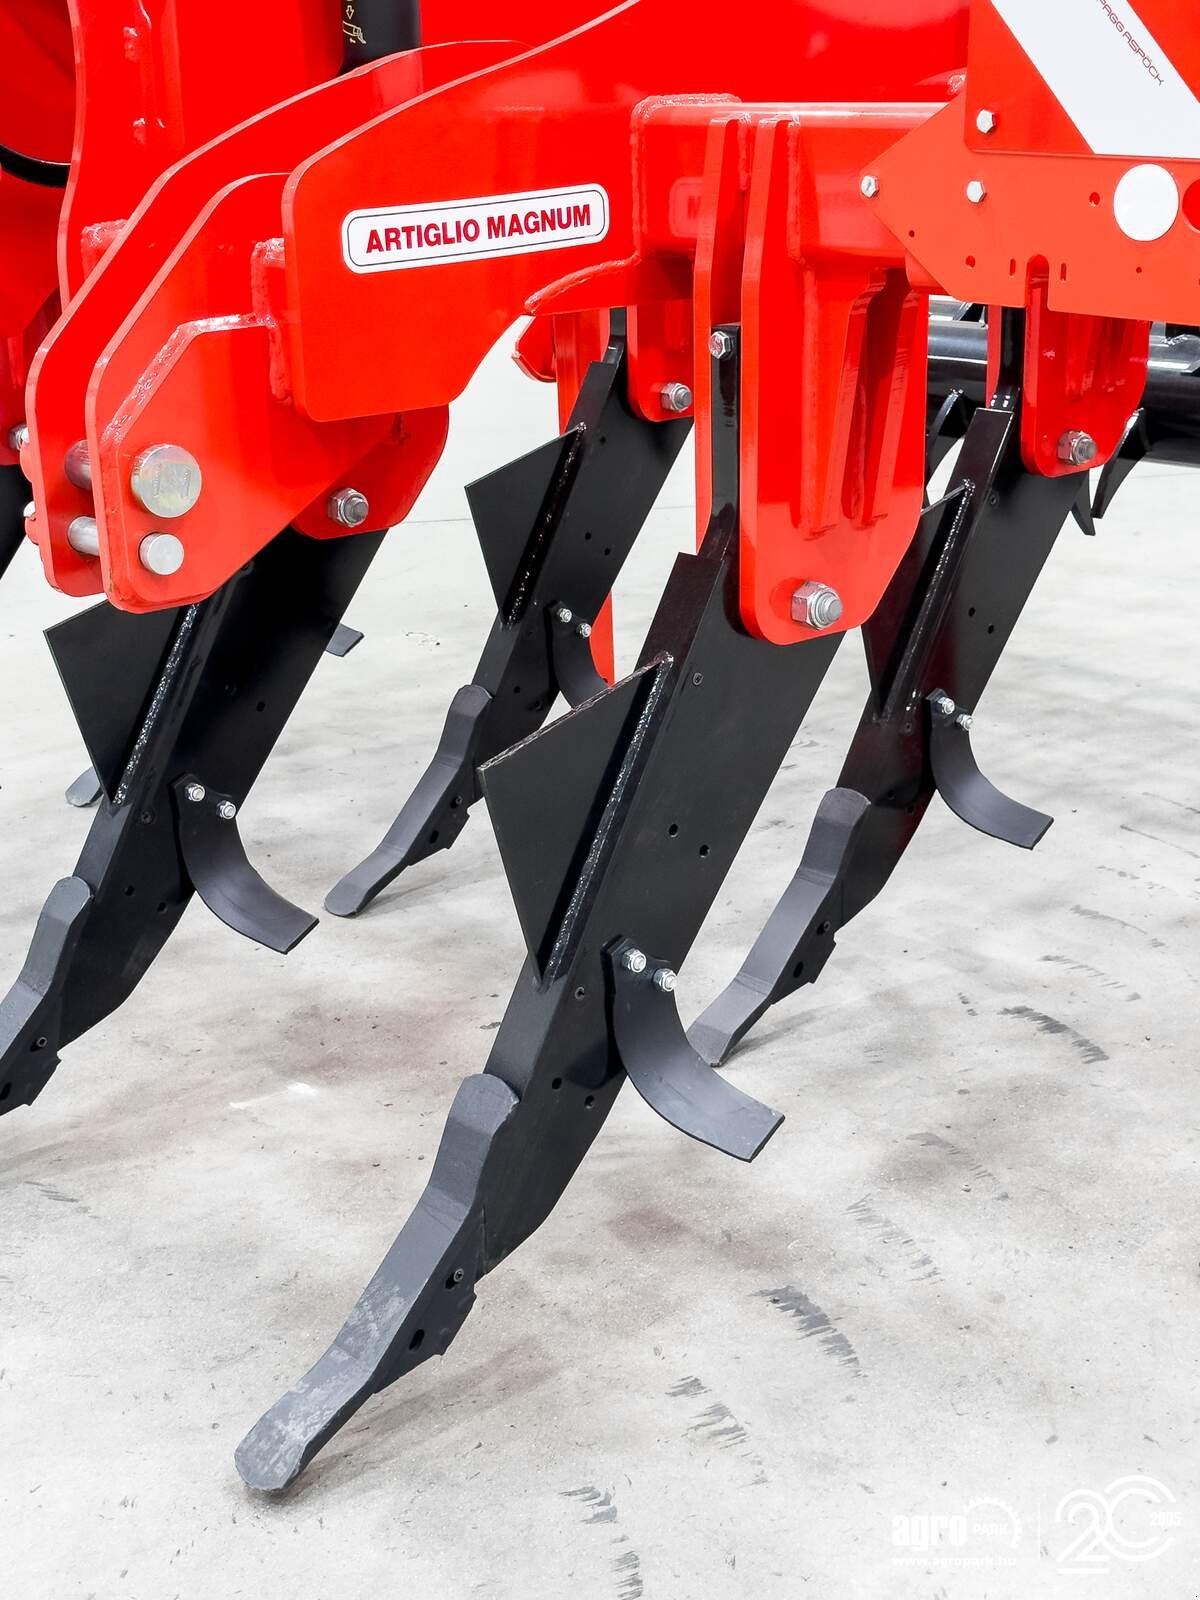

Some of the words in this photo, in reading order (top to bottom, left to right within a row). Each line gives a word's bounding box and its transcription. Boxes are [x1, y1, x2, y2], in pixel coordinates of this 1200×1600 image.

[1123, 31, 1165, 86] ASPÖCK
[366, 219, 480, 253] ARTIGLIO
[487, 204, 591, 239] MAGNUM
